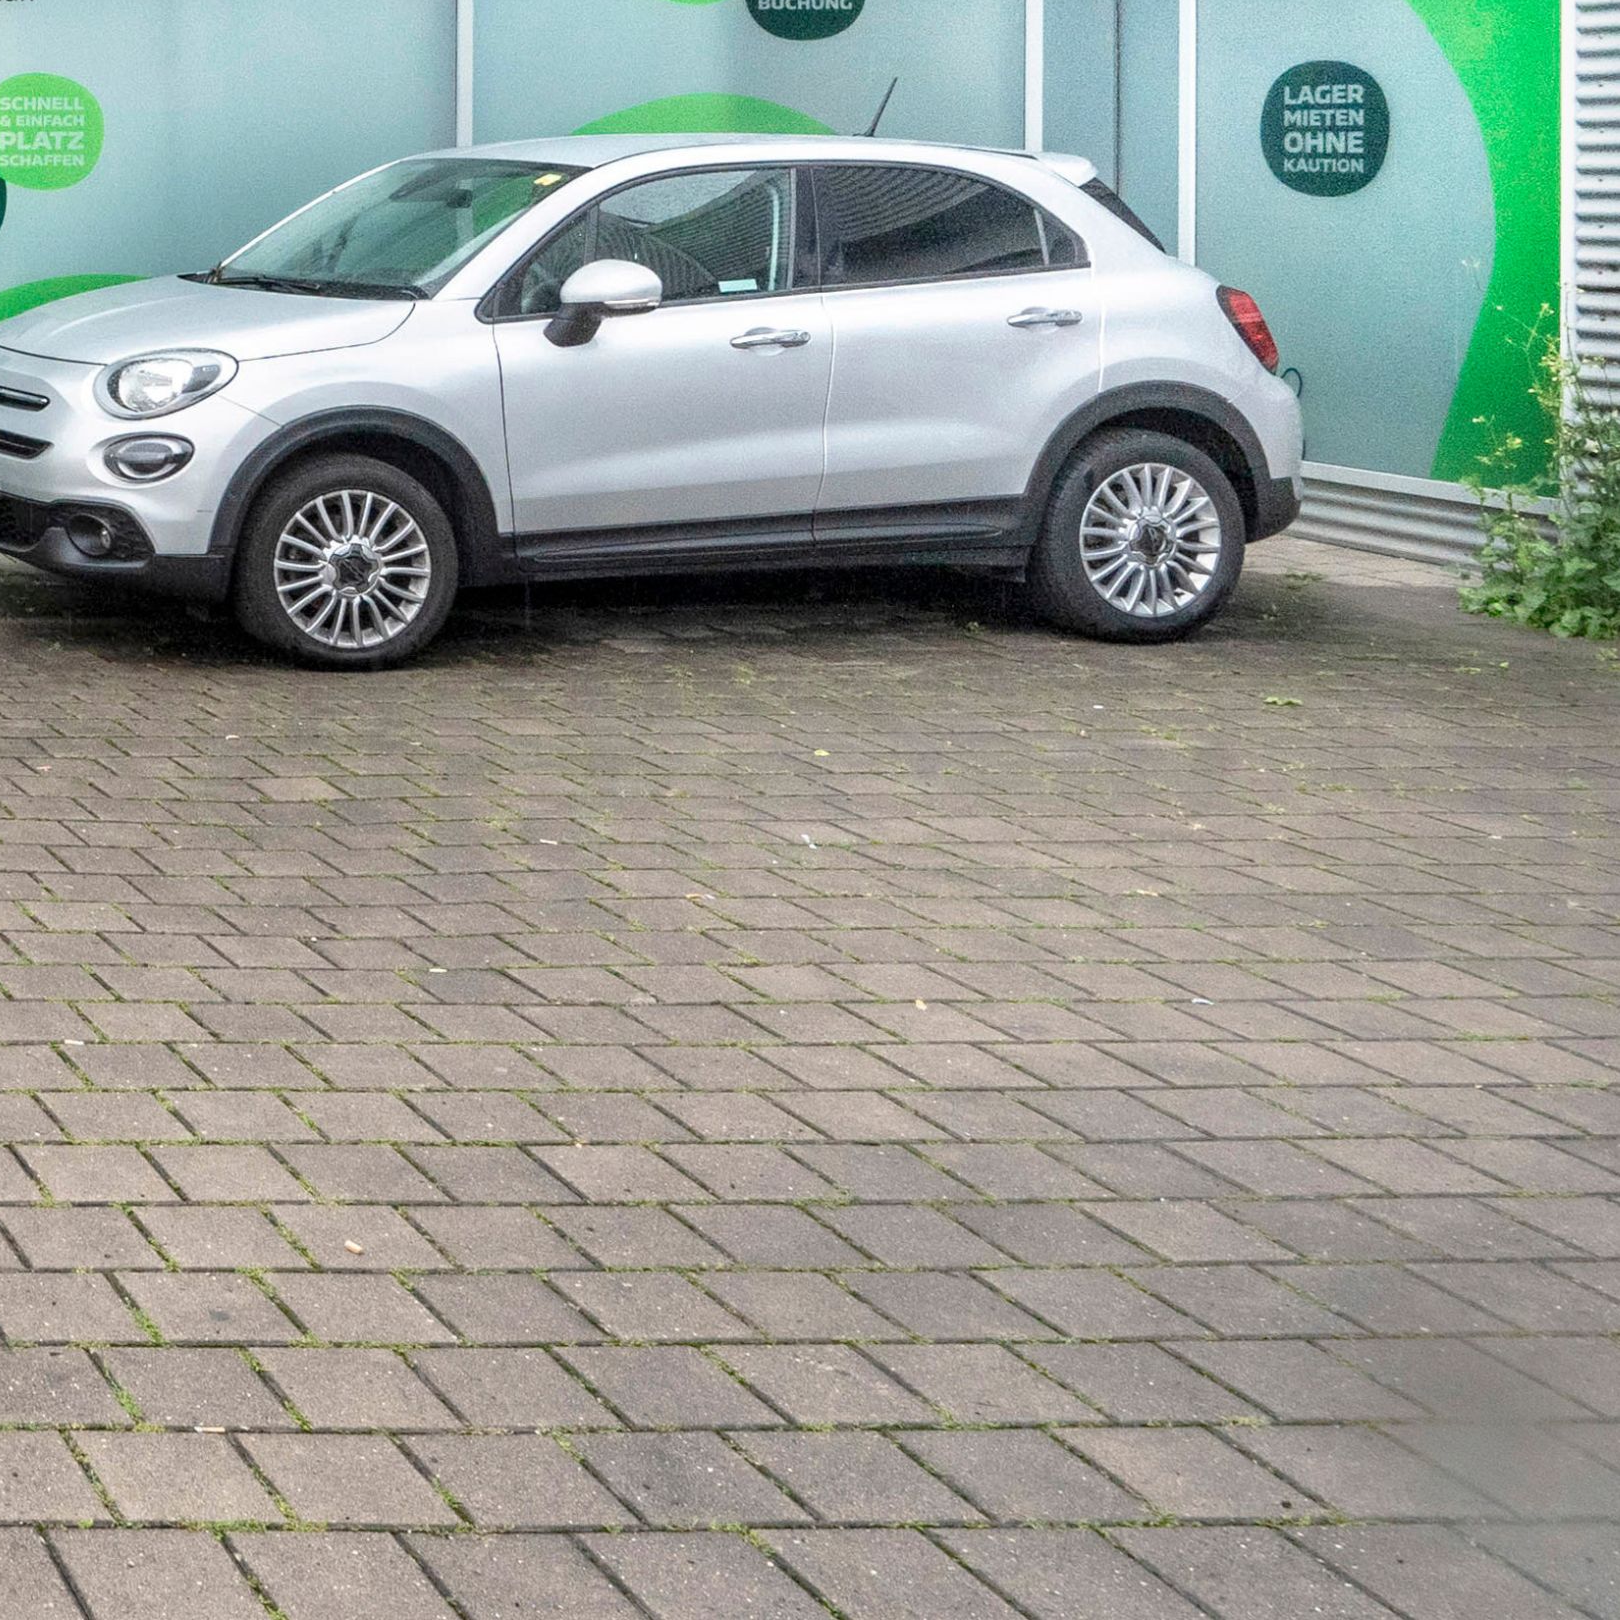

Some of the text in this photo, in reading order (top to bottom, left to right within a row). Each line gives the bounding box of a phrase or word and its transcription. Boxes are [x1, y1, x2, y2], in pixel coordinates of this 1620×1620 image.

[1283, 83, 1365, 105] LAGER
[0, 96, 85, 111] SCHNELL
[0, 115, 85, 127] & EINFACH
[1283, 108, 1365, 126] MIETEN
[1283, 131, 1365, 154] OHNE
[0, 154, 85, 167] SCHAFFEN
[1283, 158, 1365, 173] KAUTION
